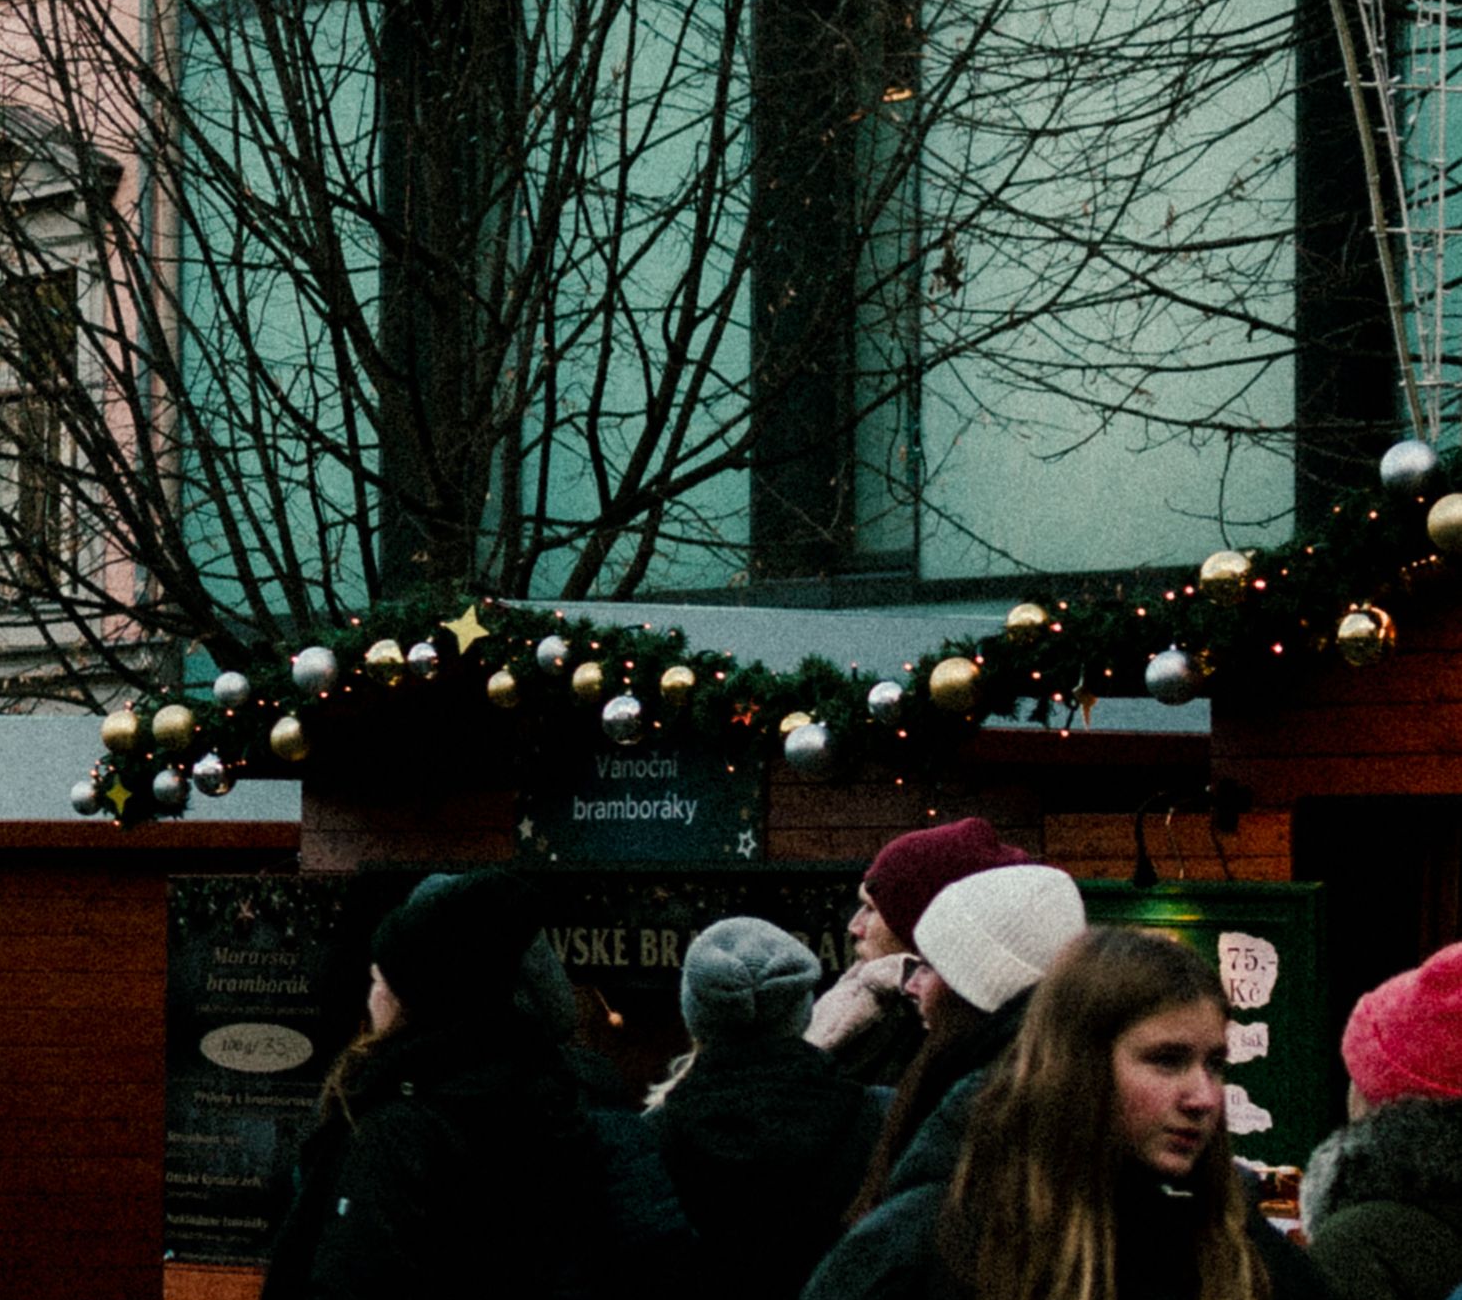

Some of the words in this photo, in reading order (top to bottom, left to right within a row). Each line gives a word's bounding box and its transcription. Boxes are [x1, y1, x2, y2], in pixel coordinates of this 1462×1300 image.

[595, 751, 679, 780] Vánoční
[572, 790, 698, 825] bramboráky
[205, 973, 311, 995] bramborák
[1228, 977, 1262, 1004] Kč
